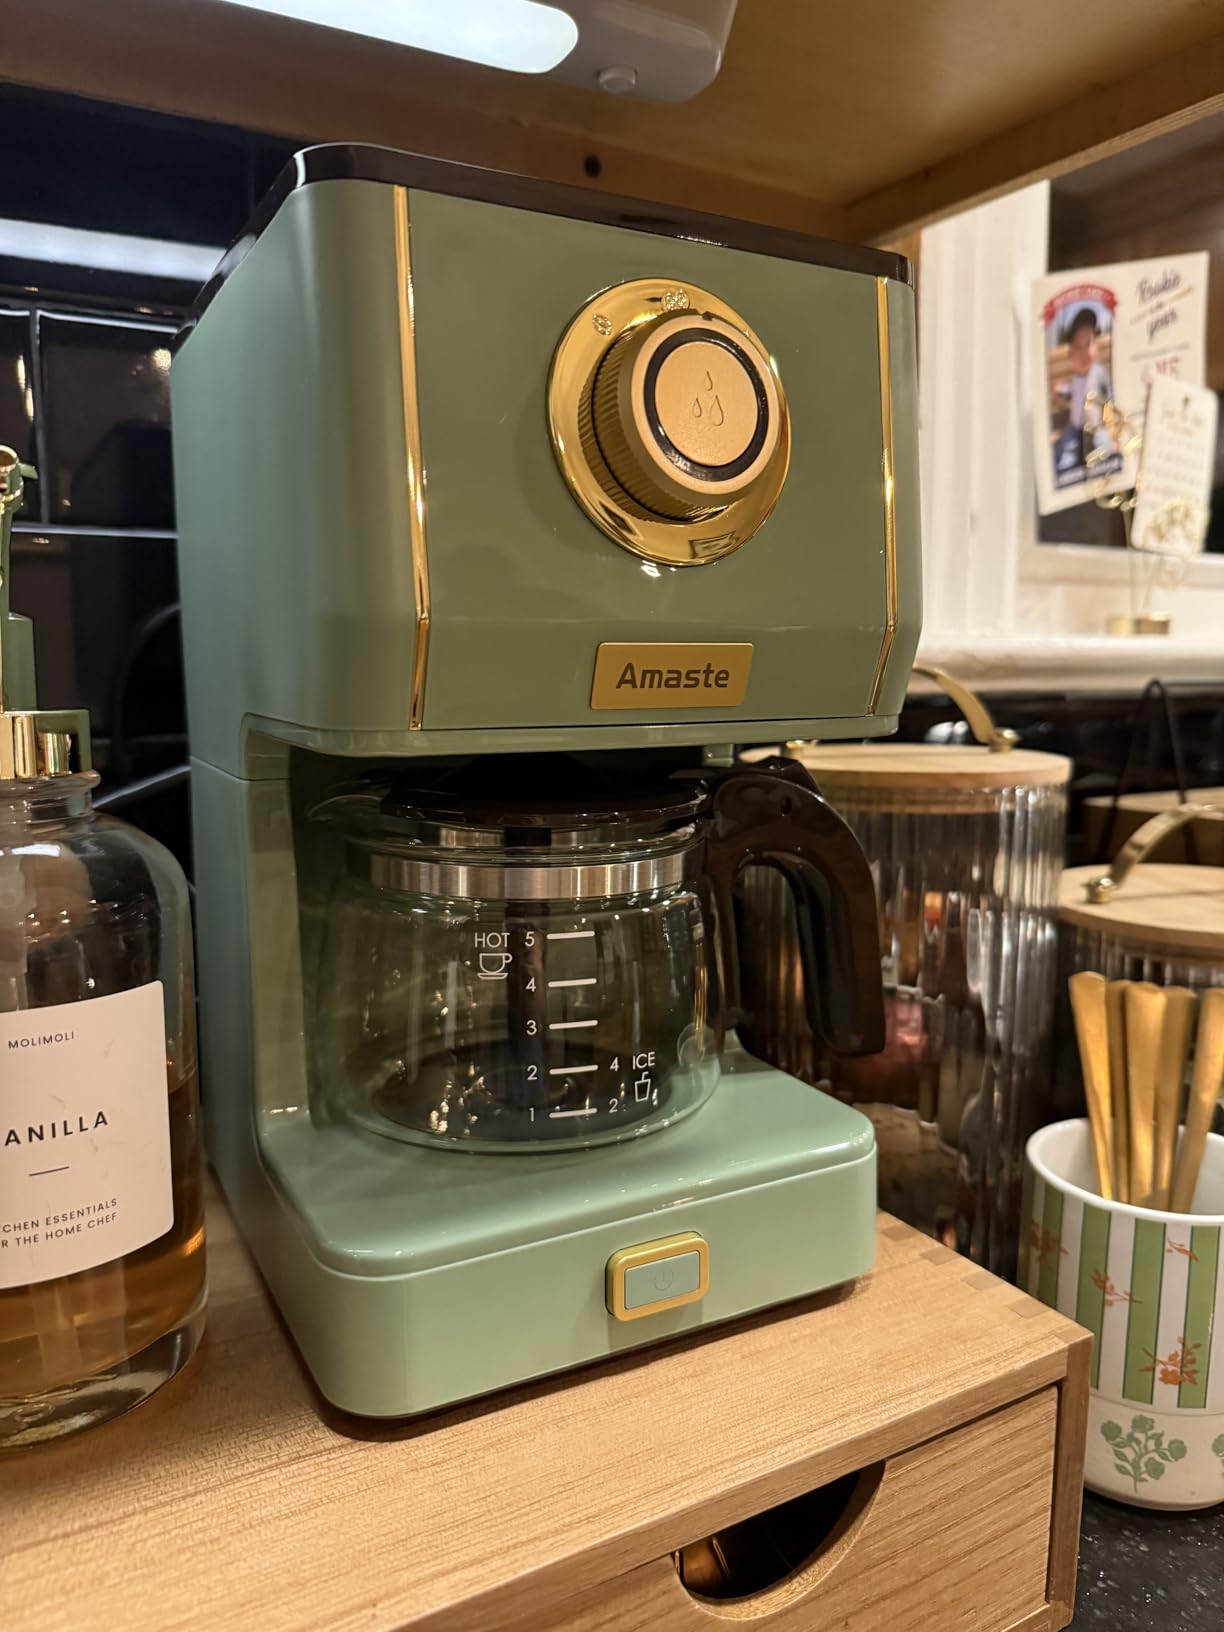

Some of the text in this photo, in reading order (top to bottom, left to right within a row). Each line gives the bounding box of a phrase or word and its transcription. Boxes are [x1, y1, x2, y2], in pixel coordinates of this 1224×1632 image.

[615, 661, 730, 689] Amaste
[474, 932, 511, 949] HOT
[524, 931, 536, 948] 5
[525, 977, 537, 993] 4
[526, 1020, 538, 1036] 3
[8, 1031, 75, 1049] MOLIMOLI
[609, 1056, 620, 1072] 4
[632, 1051, 656, 1070] ICE
[527, 1065, 538, 1081] 2
[529, 1107, 535, 1122] 1
[608, 1098, 619, 1114] 2
[4, 1110, 109, 1146] ANILLA
[0, 1198, 118, 1233] CHEN ESSENTIALS
[15, 1233, 40, 1247] THE
[45, 1223, 82, 1241] HOME
[87, 1211, 118, 1229] CHEF
